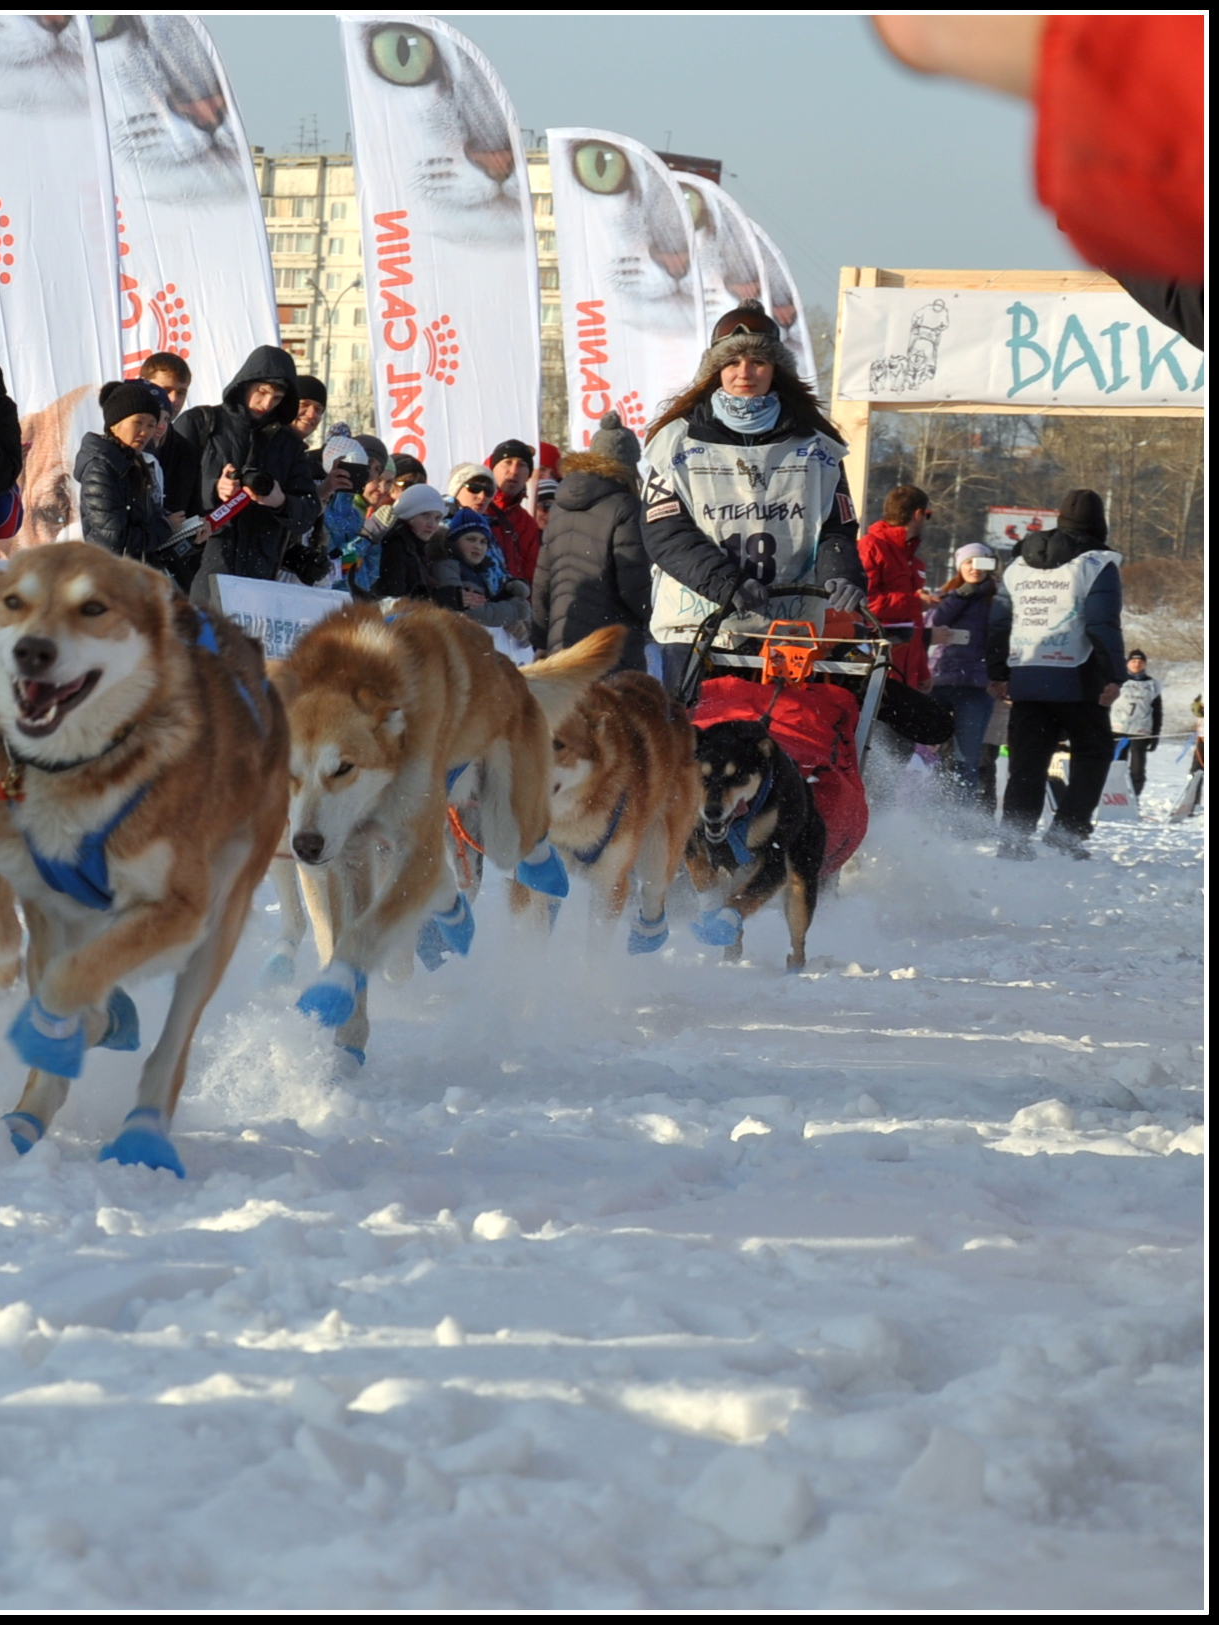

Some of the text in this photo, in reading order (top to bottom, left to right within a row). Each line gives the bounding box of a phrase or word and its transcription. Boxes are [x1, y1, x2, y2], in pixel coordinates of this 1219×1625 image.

[1005, 301, 1204, 399] BAIK
[213, 506, 228, 519] LIFE
[720, 532, 777, 585] 18
